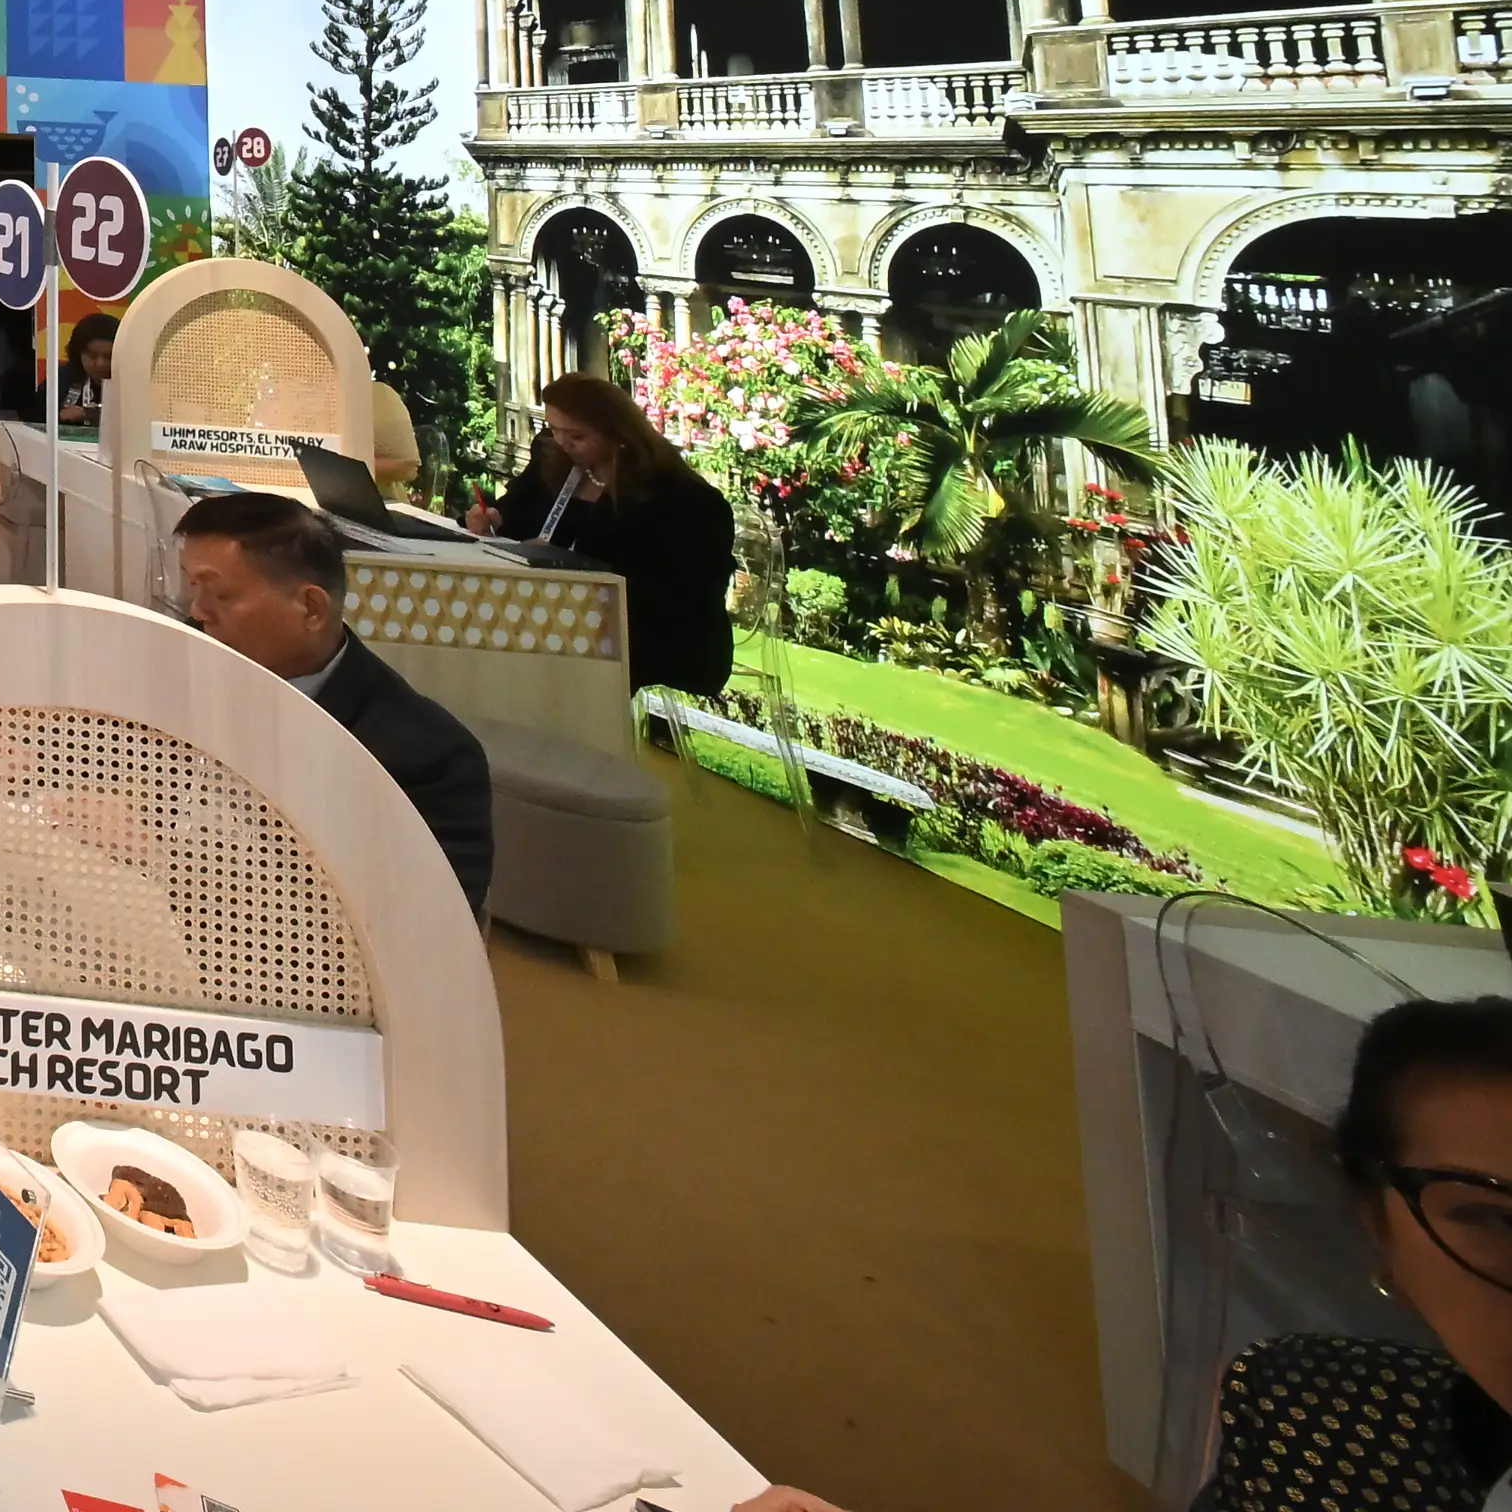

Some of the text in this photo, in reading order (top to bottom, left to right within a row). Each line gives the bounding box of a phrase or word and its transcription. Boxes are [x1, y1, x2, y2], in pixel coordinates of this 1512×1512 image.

[215, 146, 229, 168] 27
[241, 136, 265, 159] 28
[71, 192, 125, 267] 22
[162, 426, 196, 439] LIHIM
[258, 433, 272, 445] EL
[171, 439, 207, 451] ARAW
[81, 1016, 294, 1073] MARIBAGO
[47, 1054, 210, 1105] RESORT
